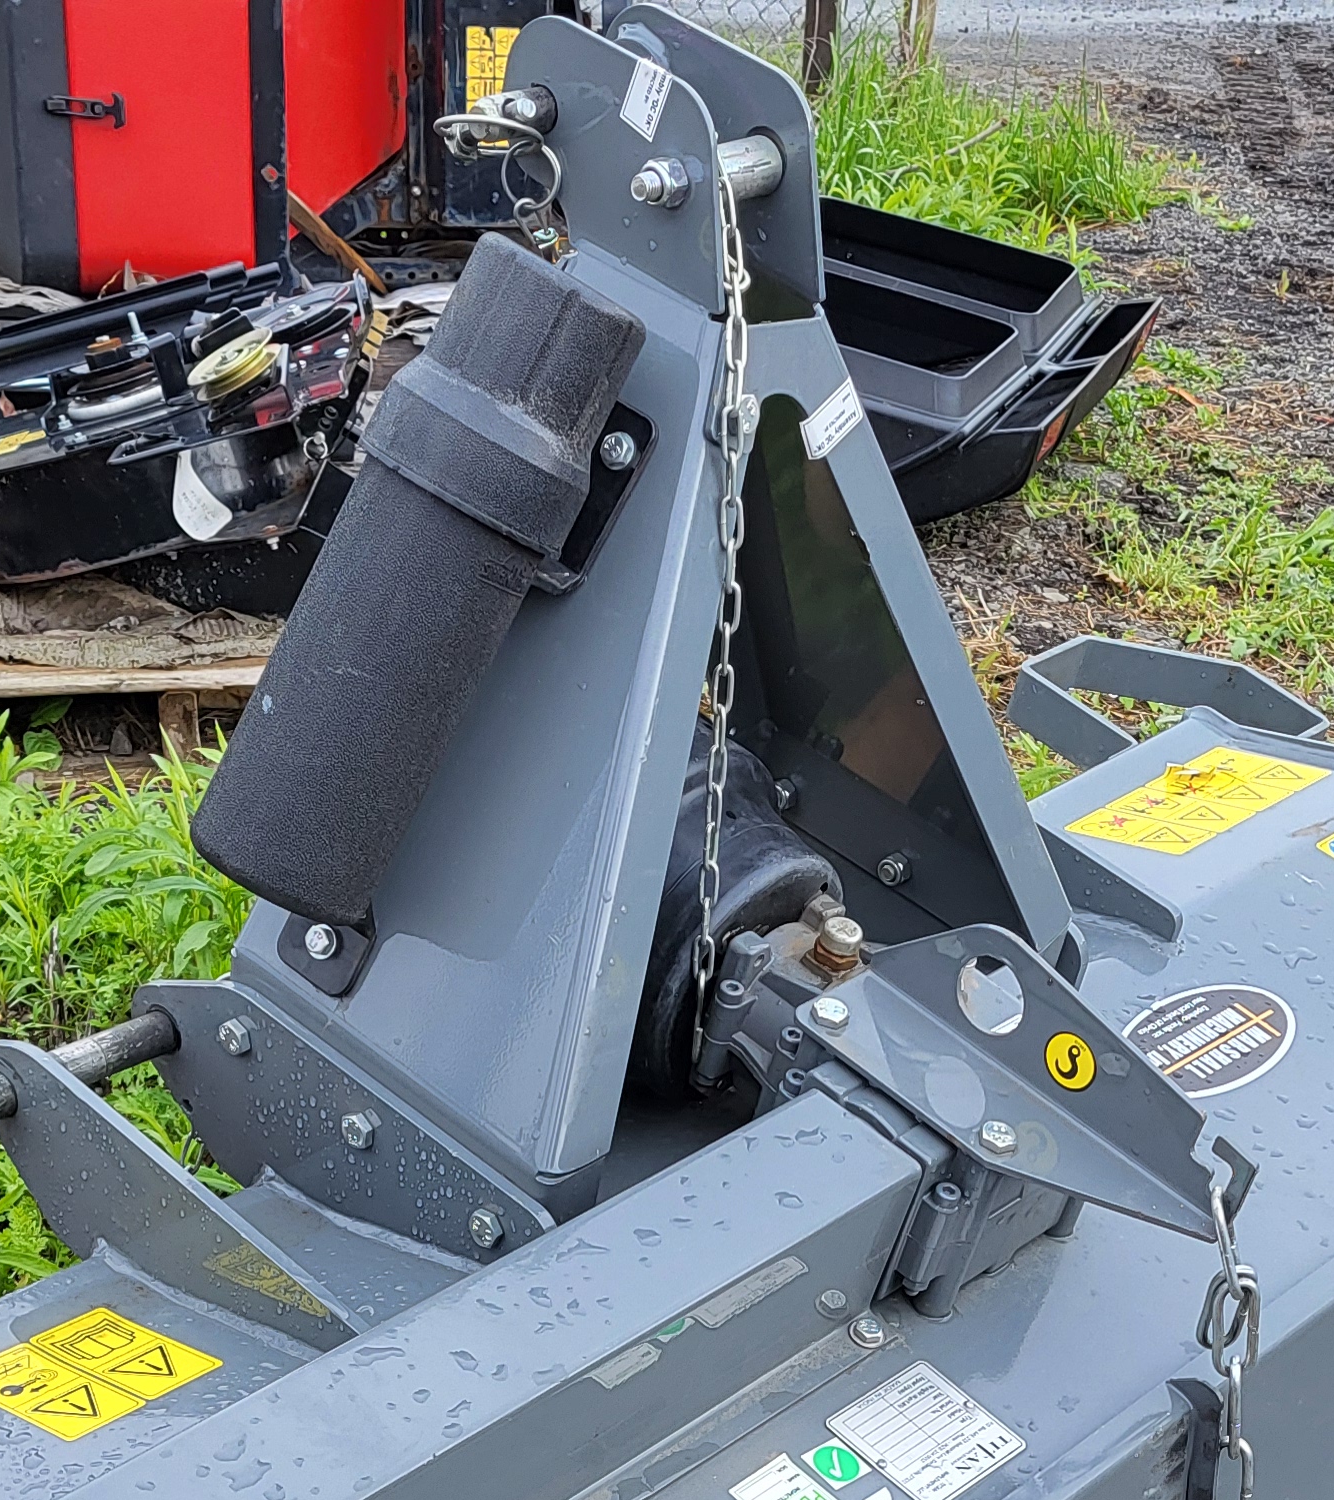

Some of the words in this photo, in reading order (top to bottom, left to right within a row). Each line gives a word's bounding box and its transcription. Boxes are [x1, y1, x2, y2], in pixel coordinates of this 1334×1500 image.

[1157, 1007, 1247, 1059] MACHINERY,
[1182, 1025, 1273, 1079] MARSHALL
[953, 1434, 1013, 1475] TITAN
